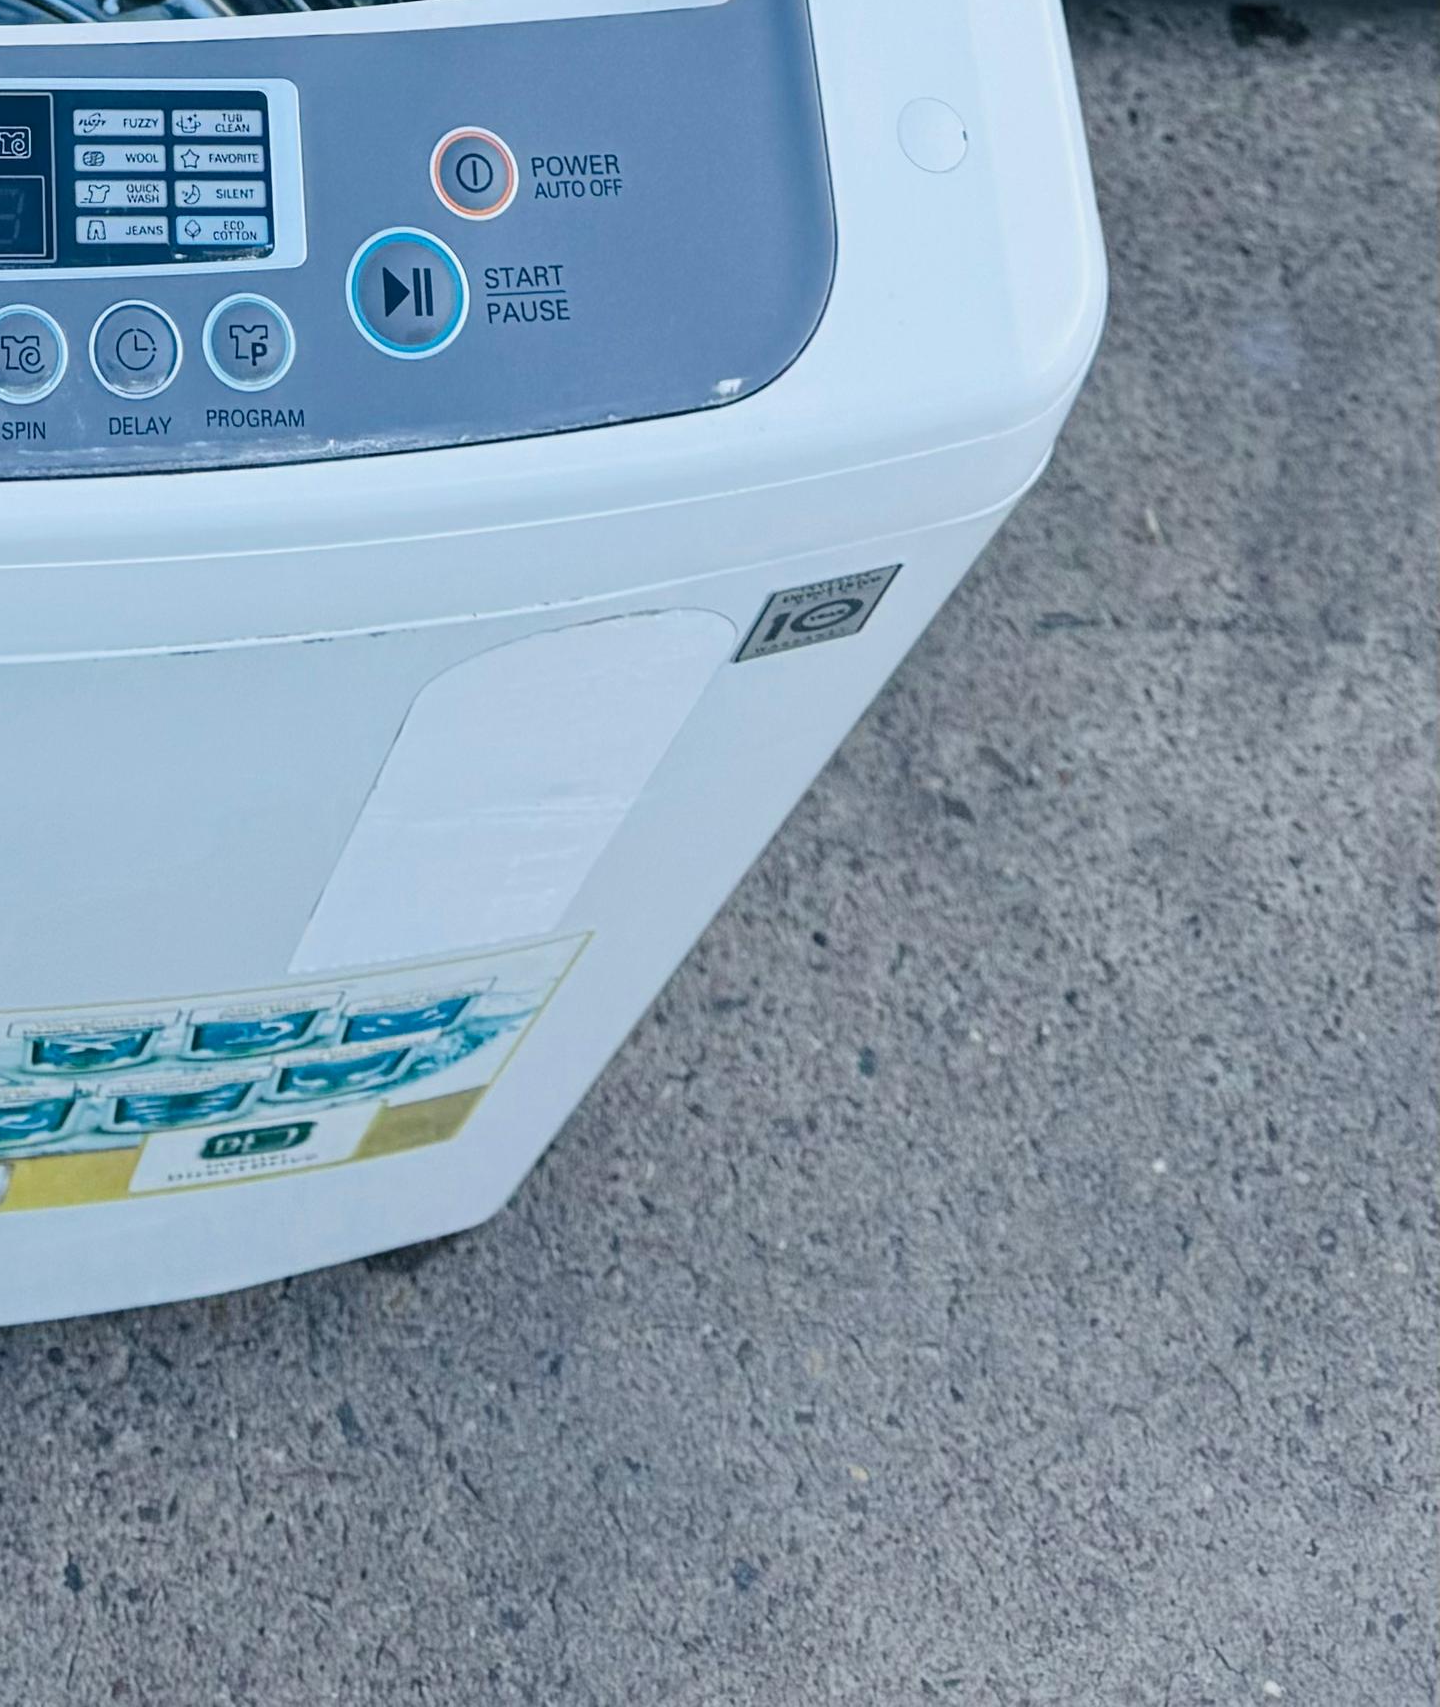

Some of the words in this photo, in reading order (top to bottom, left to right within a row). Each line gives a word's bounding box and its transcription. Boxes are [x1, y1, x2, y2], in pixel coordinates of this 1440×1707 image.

[222, 113, 243, 122] TUB
[123, 118, 159, 129] FUZZY
[215, 124, 250, 133] CLEAN
[125, 153, 160, 164] WOOL
[209, 153, 260, 164] FAVORITE
[531, 154, 621, 178] POWER
[126, 184, 160, 194] QUICK
[216, 189, 254, 199] SILENT
[534, 180, 586, 199] AUTO
[590, 178, 623, 197] OFF
[127, 194, 160, 204] WASH
[126, 225, 163, 236] JEANS
[224, 220, 244, 230] ECO
[213, 231, 257, 240] COTTON
[485, 265, 564, 289] START
[487, 299, 571, 324] PAUSE
[206, 409, 305, 428] PROGRAM
[1, 421, 46, 440] SPIN
[109, 416, 171, 435] DELAY
